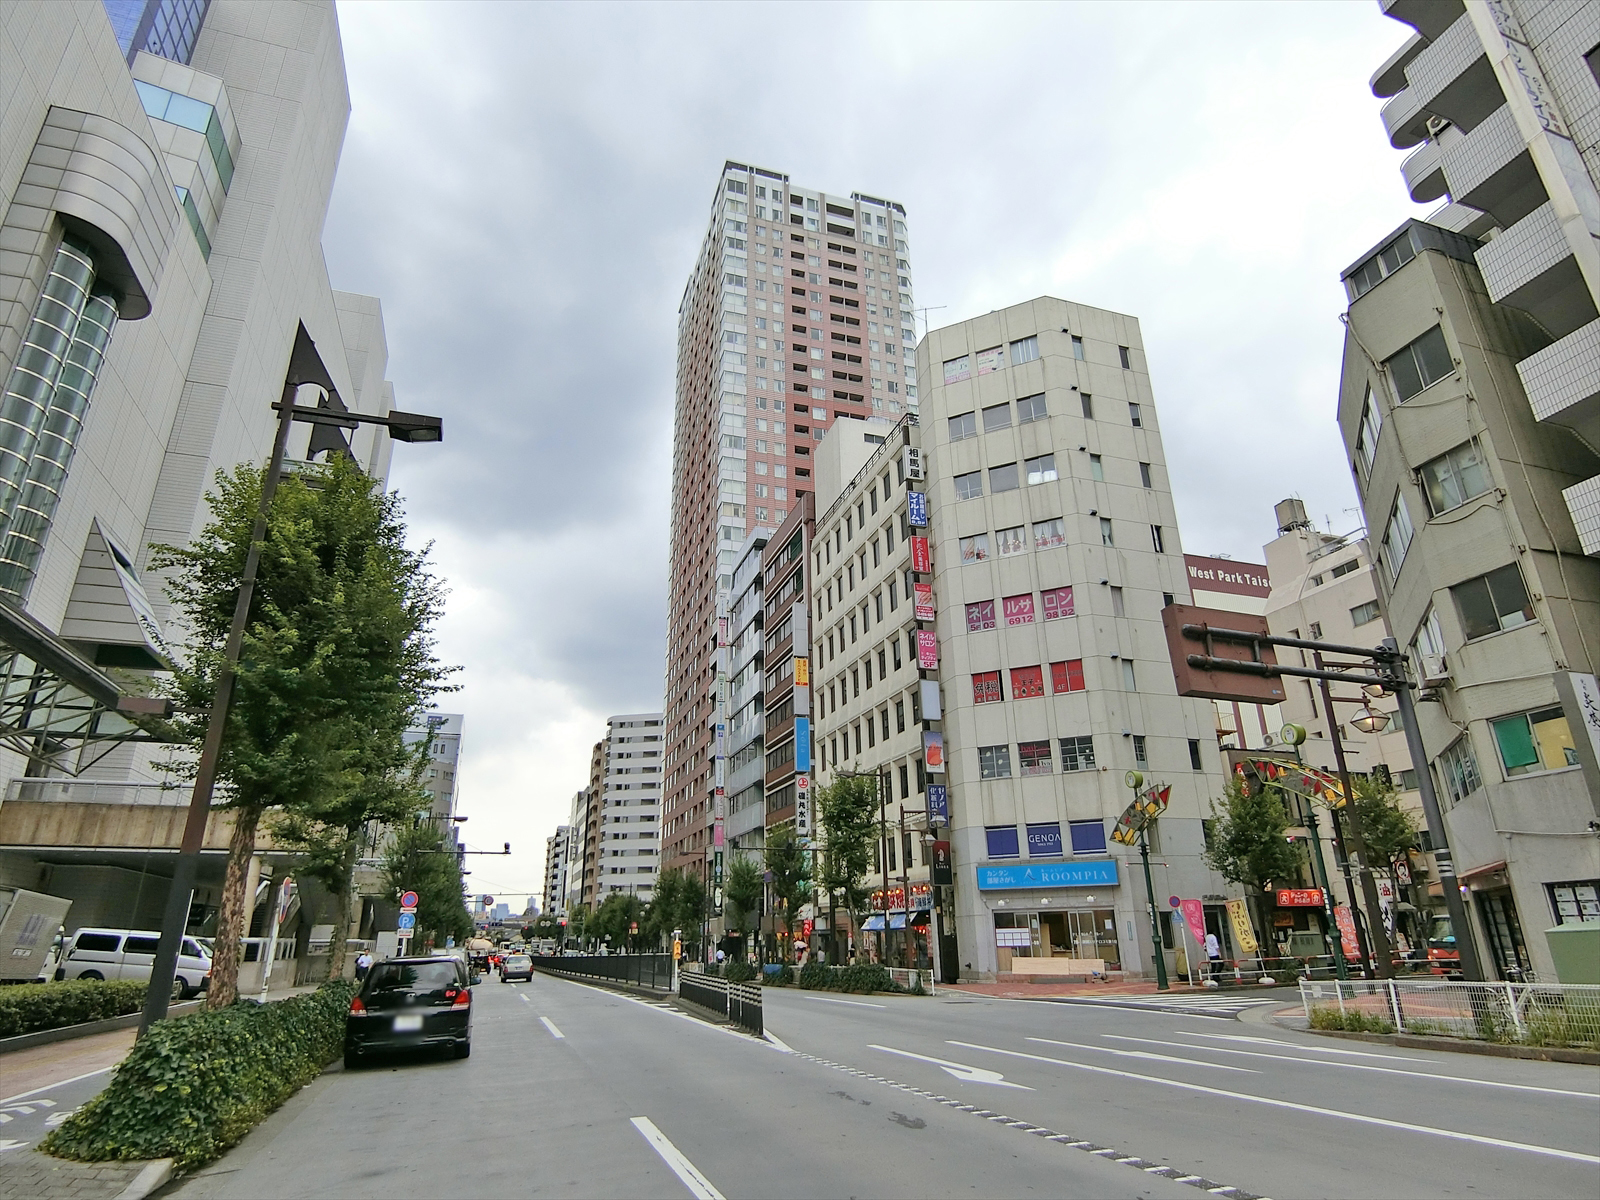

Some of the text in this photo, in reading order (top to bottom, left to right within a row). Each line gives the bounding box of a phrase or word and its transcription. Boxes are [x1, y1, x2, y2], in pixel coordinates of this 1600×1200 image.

[909, 449, 920, 478] 相馬屋
[1188, 566, 1214, 580] West
[1217, 570, 1243, 584] Park
[983, 621, 995, 629] 03
[1008, 615, 1033, 625] 6912
[1056, 683, 1066, 691] 4F
[1028, 833, 1061, 843] GENOA
[1041, 870, 1109, 882] ROOMPIA
